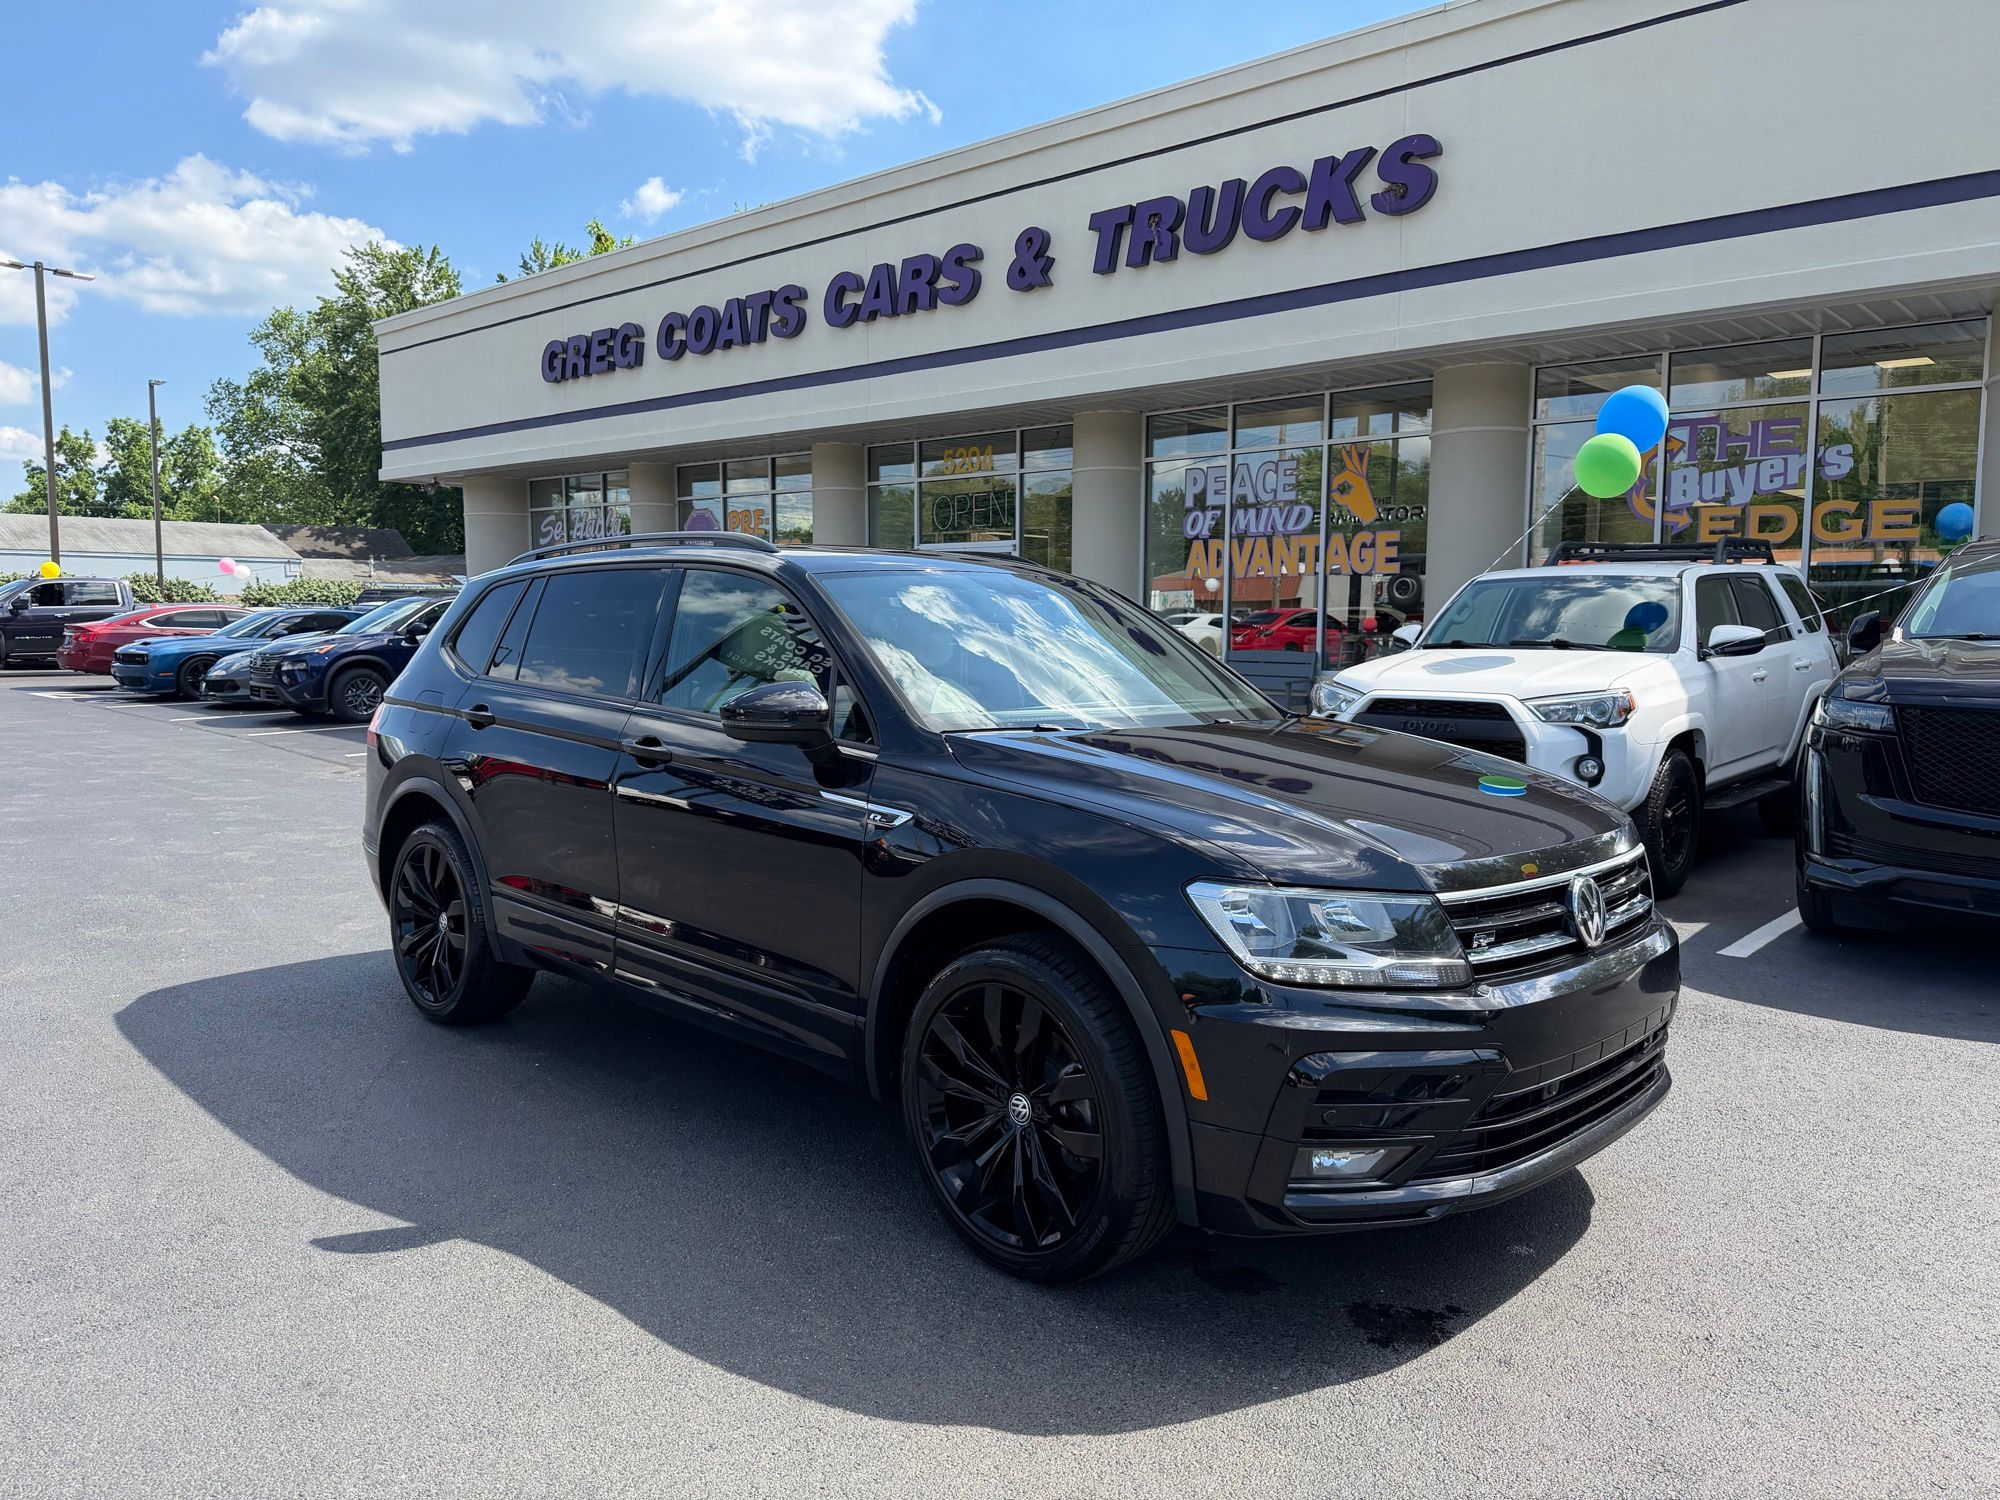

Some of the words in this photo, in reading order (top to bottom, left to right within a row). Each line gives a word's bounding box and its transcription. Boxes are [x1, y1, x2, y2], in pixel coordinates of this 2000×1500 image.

[541, 321, 645, 383] GREG
[656, 284, 808, 361] COATS
[823, 243, 983, 328] CARS
[1006, 226, 1056, 292] &
[1088, 133, 1443, 275] TRUCKS
[943, 445, 994, 475] 5204
[1669, 415, 1804, 464] THE
[1184, 459, 1298, 508] PEACE
[539, 514, 565, 545] Se
[933, 491, 1009, 530] OPEN
[1183, 508, 1222, 539] OF
[1231, 504, 1314, 538] MIND
[1696, 500, 1921, 544] EDGE
[1183, 530, 1401, 579] ADVANTAGE
[1400, 720, 1457, 733] TOYOTA
